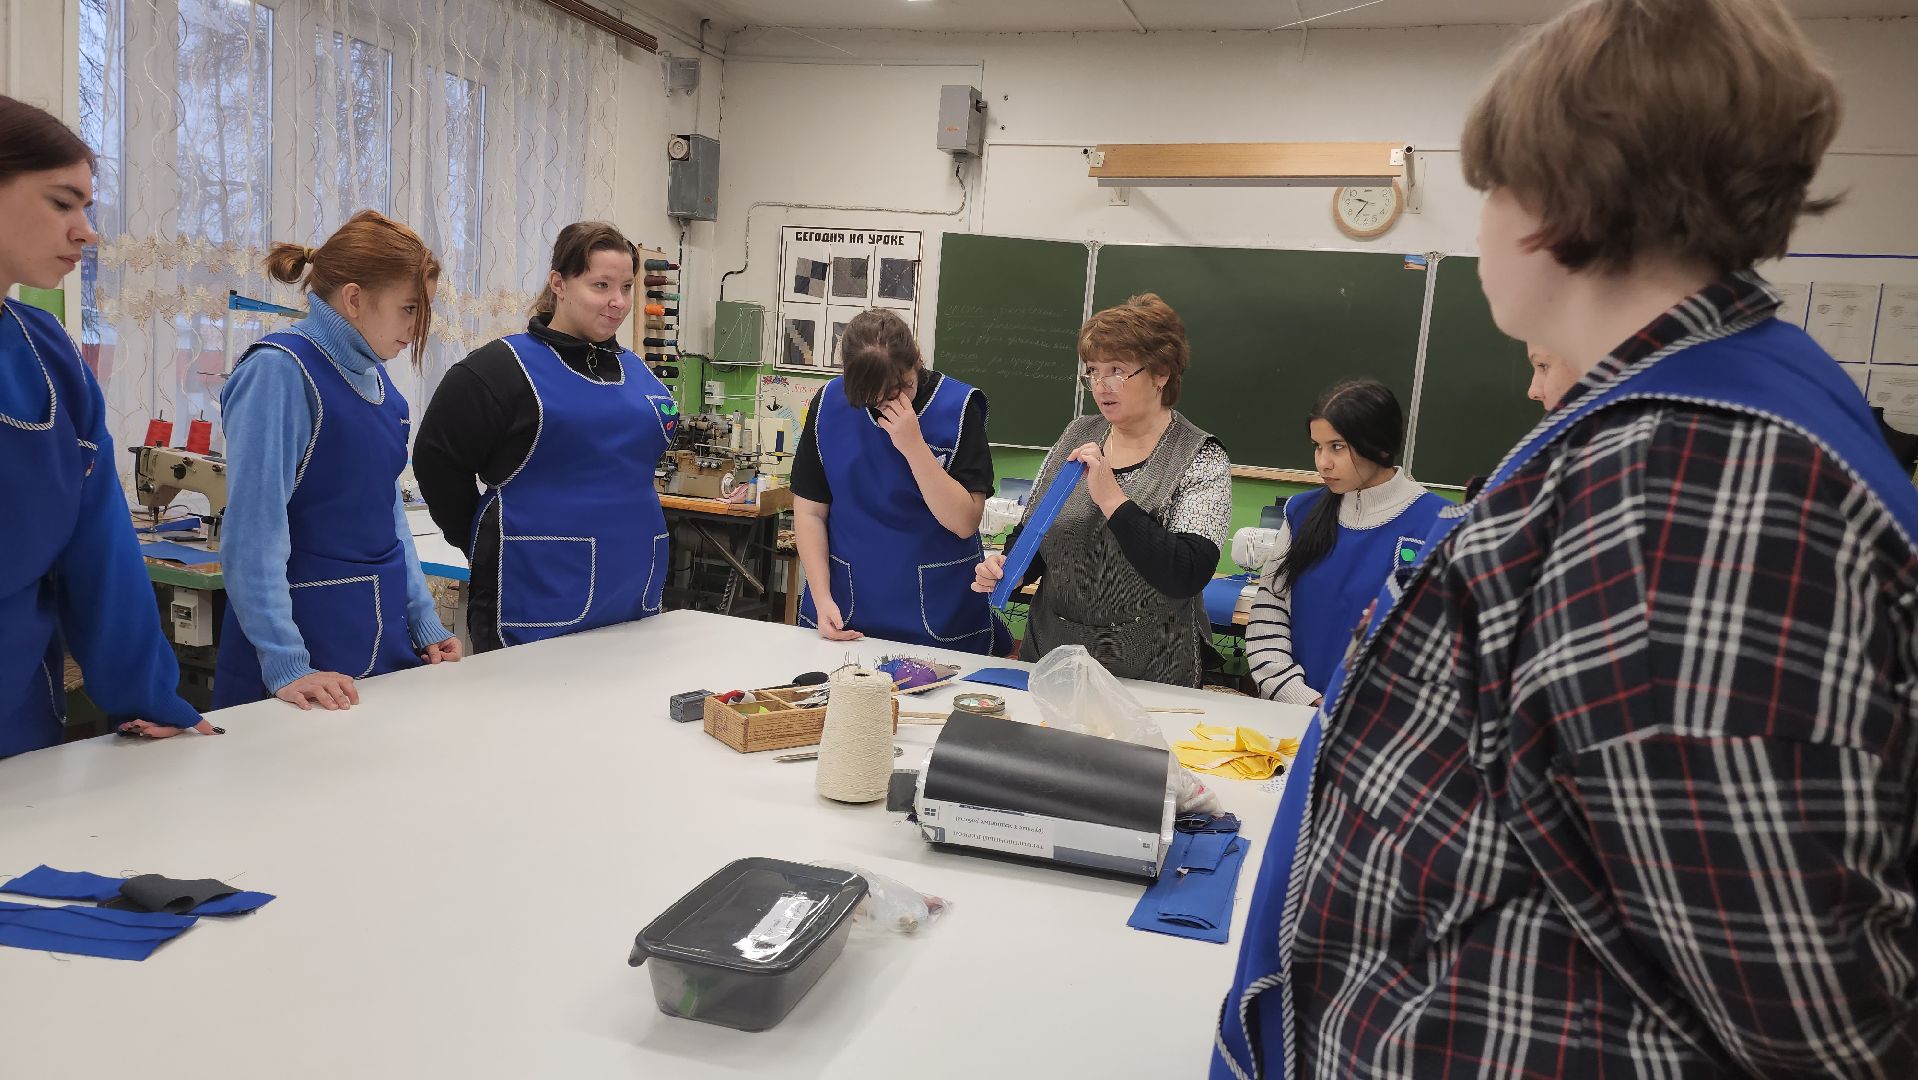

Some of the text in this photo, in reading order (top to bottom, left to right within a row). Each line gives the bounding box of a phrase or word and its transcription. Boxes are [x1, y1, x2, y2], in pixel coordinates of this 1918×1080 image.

[795, 231, 905, 246] СЕГОДНЯ НА УРОКЕ
